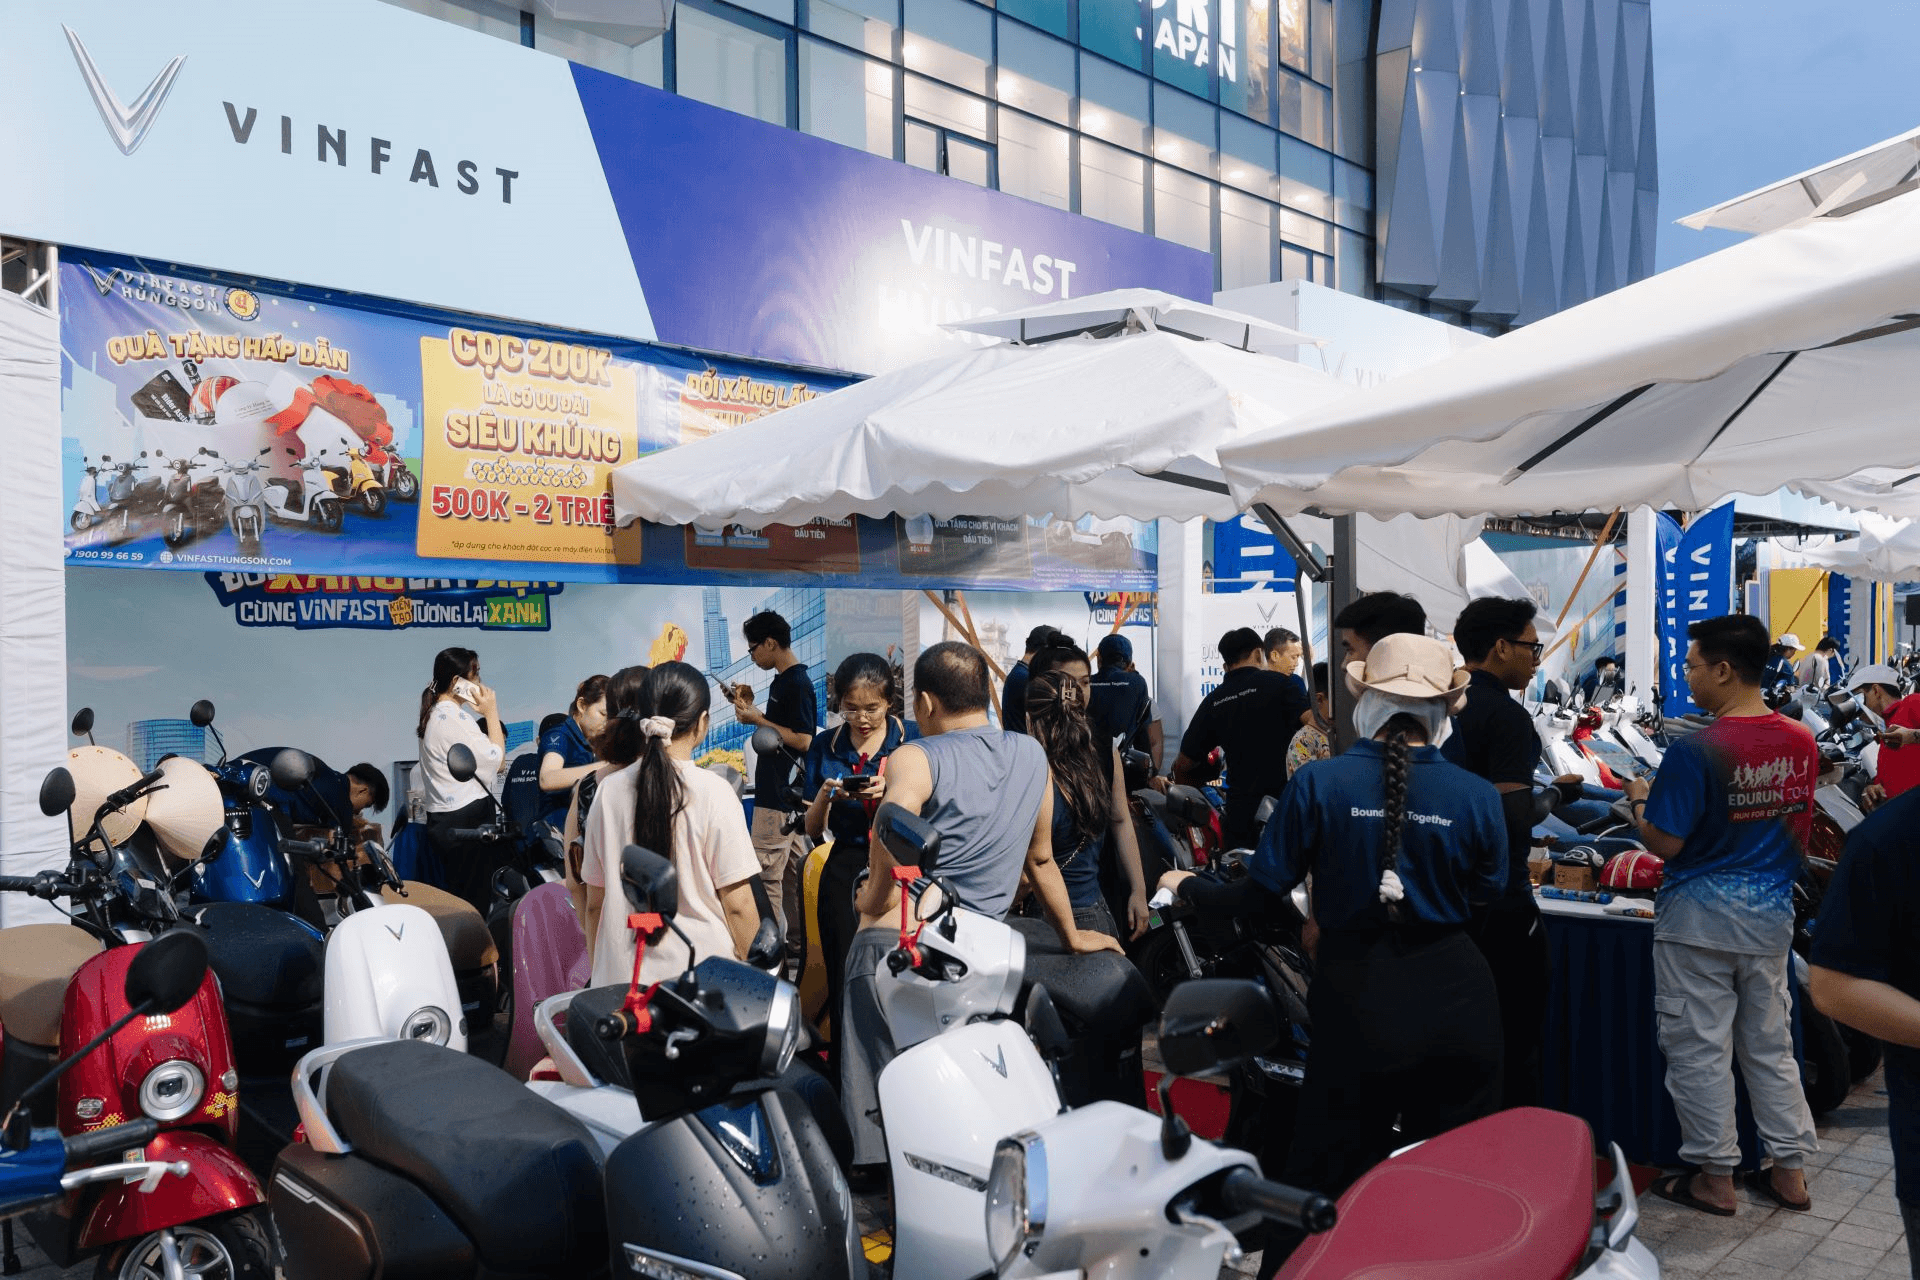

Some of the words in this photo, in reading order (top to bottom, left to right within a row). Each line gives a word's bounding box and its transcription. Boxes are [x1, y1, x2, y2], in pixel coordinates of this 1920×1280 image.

[222, 101, 520, 205] VINFAST
[901, 218, 1077, 299] VINFAST
[122, 271, 219, 298] VINFAST
[109, 331, 166, 363] QUÀ
[169, 331, 240, 363] TẶNG
[245, 334, 296, 362] HẤP
[300, 338, 348, 372] DẪN
[450, 328, 525, 380] CỌC
[528, 338, 612, 386] 200K
[720, 377, 775, 406] XĂNG
[447, 408, 519, 452] SIÊU
[523, 415, 622, 463] KHỦNG
[432, 486, 510, 521] 500K
[533, 494, 552, 523] 2
[75, 550, 99, 559] 1900
[100, 551, 114, 559] 99
[116, 552, 128, 560] 66
[130, 552, 144, 561] 59
[176, 554, 292, 566] VINFASTHUNGSON.COM
[240, 599, 297, 622] CÙNG
[411, 600, 462, 623] TƯƠNG
[488, 602, 541, 624] XANH
[1728, 788, 1784, 806] EDURUN
[1407, 811, 1453, 826] Together
